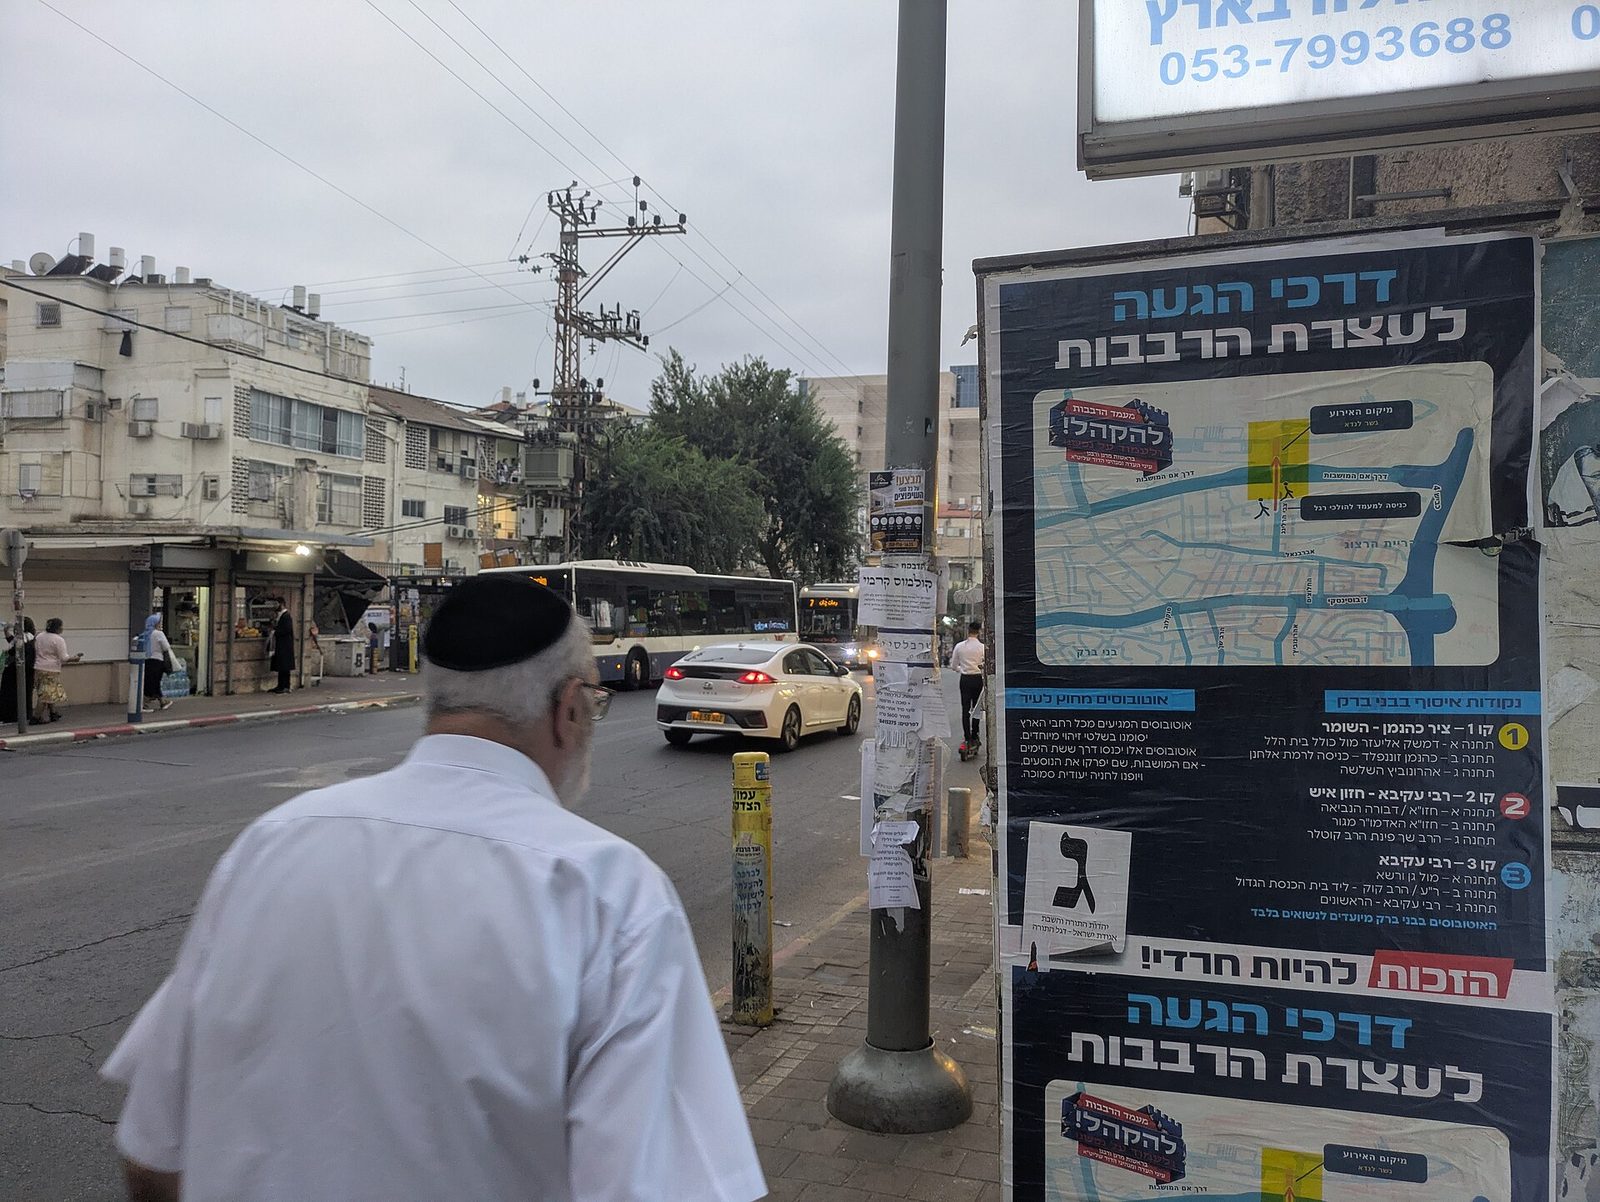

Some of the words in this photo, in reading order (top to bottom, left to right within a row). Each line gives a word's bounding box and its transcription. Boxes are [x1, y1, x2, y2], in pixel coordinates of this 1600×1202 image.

[1160, 13, 1512, 86] 053-7993688
[1270, 270, 1397, 307] דרכי
[1113, 282, 1254, 321] הגעה
[1267, 307, 1466, 352] לעצרת
[1054, 327, 1252, 368] הרבבות
[1072, 404, 1108, 416] הרבבות
[1110, 410, 1136, 420] מעמד
[1329, 409, 1362, 418] האירוע
[1365, 406, 1393, 416] מיקום
[1063, 416, 1164, 445] להקהל!
[1180, 470, 1195, 478] דרך
[1372, 473, 1388, 481] דרך
[1329, 503, 1354, 511] להולכי
[1356, 502, 1383, 510] למעמד
[1344, 540, 1378, 550] הרצוג
[1285, 549, 1315, 558] אברבנאל
[1076, 648, 1098, 658] ברק
[1102, 648, 1118, 656] בני
[1019, 693, 1052, 704] לעיר
[1056, 694, 1095, 705] מחוץ
[1096, 695, 1168, 705] אוטובוסים
[1337, 696, 1372, 708] ברק
[1375, 697, 1411, 708] בבני
[1414, 697, 1462, 709] איסוף
[1465, 697, 1521, 710] נקודות
[1019, 719, 1046, 728] הארץ
[1048, 719, 1072, 728] רחבי
[1073, 718, 1095, 728] מכל
[1097, 720, 1138, 729] המגיעים
[1140, 720, 1192, 730] אוטובוסים
[1321, 722, 1369, 733] השומר
[1382, 723, 1424, 735] כהנמן
[1427, 724, 1451, 734] ציר
[1467, 723, 1473, 735] 1
[1478, 724, 1494, 737] קו
[1019, 731, 1060, 740] מיוחדים.
[1061, 732, 1081, 741] זיהוי
[1083, 731, 1116, 741] בשלטי
[1119, 733, 1148, 742] יסומנו
[1264, 735, 1286, 746] הלל
[1507, 728, 1520, 745] 1
[1289, 737, 1309, 746] בית
[1311, 736, 1336, 747] כולל
[1338, 737, 1359, 747] מול
[1361, 738, 1400, 748] אליעזר
[1403, 739, 1440, 750] דמשק
[1449, 740, 1459, 749] א
[1461, 740, 1494, 750] תחנה
[1020, 744, 1048, 753] הימים
[1050, 745, 1076, 754] ששת
[1078, 745, 1097, 755] דרך
[1099, 745, 1124, 755] יכנסו
[1126, 745, 1143, 755] אלו
[1145, 746, 1196, 756] אוטובוסים
[1282, 750, 1314, 760] לרמת
[1316, 751, 1350, 761] כניסה
[1404, 753, 1438, 763] כהנמן
[1450, 754, 1459, 763] ב
[1462, 754, 1494, 764] תחנה
[1064, 757, 1080, 766] את
[1082, 758, 1109, 768] יפרקו
[1111, 759, 1128, 768] שם
[1130, 759, 1180, 769] המושבות,
[1182, 761, 1198, 769] אם
[1020, 769, 1055, 779] סמוכה.
[1057, 770, 1087, 779] יעודית
[1090, 771, 1118, 780] לחניה
[1120, 772, 1143, 781] ויופנו
[1309, 787, 1336, 798] איש
[1340, 788, 1365, 800] חזון
[1378, 789, 1424, 802] עקיבא
[1427, 791, 1450, 802] רבי
[1466, 790, 1476, 802] 2
[1479, 792, 1495, 805] קו
[1505, 797, 1525, 815] 2
[1306, 829, 1341, 841] קוטלר
[1344, 831, 1367, 840] הרב
[1370, 832, 1396, 842] פינת
[1397, 833, 1415, 843] שך
[1418, 834, 1441, 843] הרב
[1454, 835, 1460, 844] ג
[1463, 835, 1495, 846] תחנה
[1379, 855, 1425, 868] עקיבא
[1428, 857, 1452, 869] רבי
[1467, 857, 1477, 870] 3
[1480, 860, 1496, 872] קו
[1052, 831, 1096, 914] ג
[1506, 867, 1525, 884] 3
[1235, 876, 1266, 887] הגדול
[1268, 879, 1306, 890] הכנסת
[1308, 881, 1329, 891] בית
[1331, 882, 1349, 892] ליד
[1362, 884, 1383, 895] קוק
[1386, 885, 1409, 894] הרב
[1420, 886, 1439, 896] ר"ע
[1452, 888, 1461, 898] ב
[1464, 889, 1497, 899] תחנה
[1250, 908, 1280, 918] בלבד
[1282, 910, 1327, 920] לנשואים
[1329, 912, 1373, 923] מיועדים
[1041, 914, 1065, 926] והשבת
[1065, 918, 1088, 927] התורה
[1376, 915, 1399, 925] ברק
[1402, 916, 1427, 926] בבני
[1429, 918, 1497, 930] האוטובוסים
[1032, 923, 1054, 932] התורה
[1055, 926, 1066, 934] דגל
[1088, 920, 1110, 931] יהדות
[1072, 928, 1096, 938] ישראל
[1096, 932, 1118, 942] אגודת
[1141, 945, 1240, 978] חרדי!
[1250, 951, 1357, 983] להיות
[1376, 964, 1499, 997] הזכות
[1127, 994, 1269, 1034] הגעה
[1285, 1008, 1412, 1048] דרכי
[1067, 1033, 1266, 1079] הרבבות
[1281, 1054, 1483, 1102] לעצרת
[1085, 1100, 1121, 1117] הרבבות
[1123, 1112, 1149, 1126] מעמד
[1075, 1109, 1177, 1155] להקהל!
[1343, 1151, 1376, 1161] האירוע
[1379, 1155, 1407, 1165] מיקום
